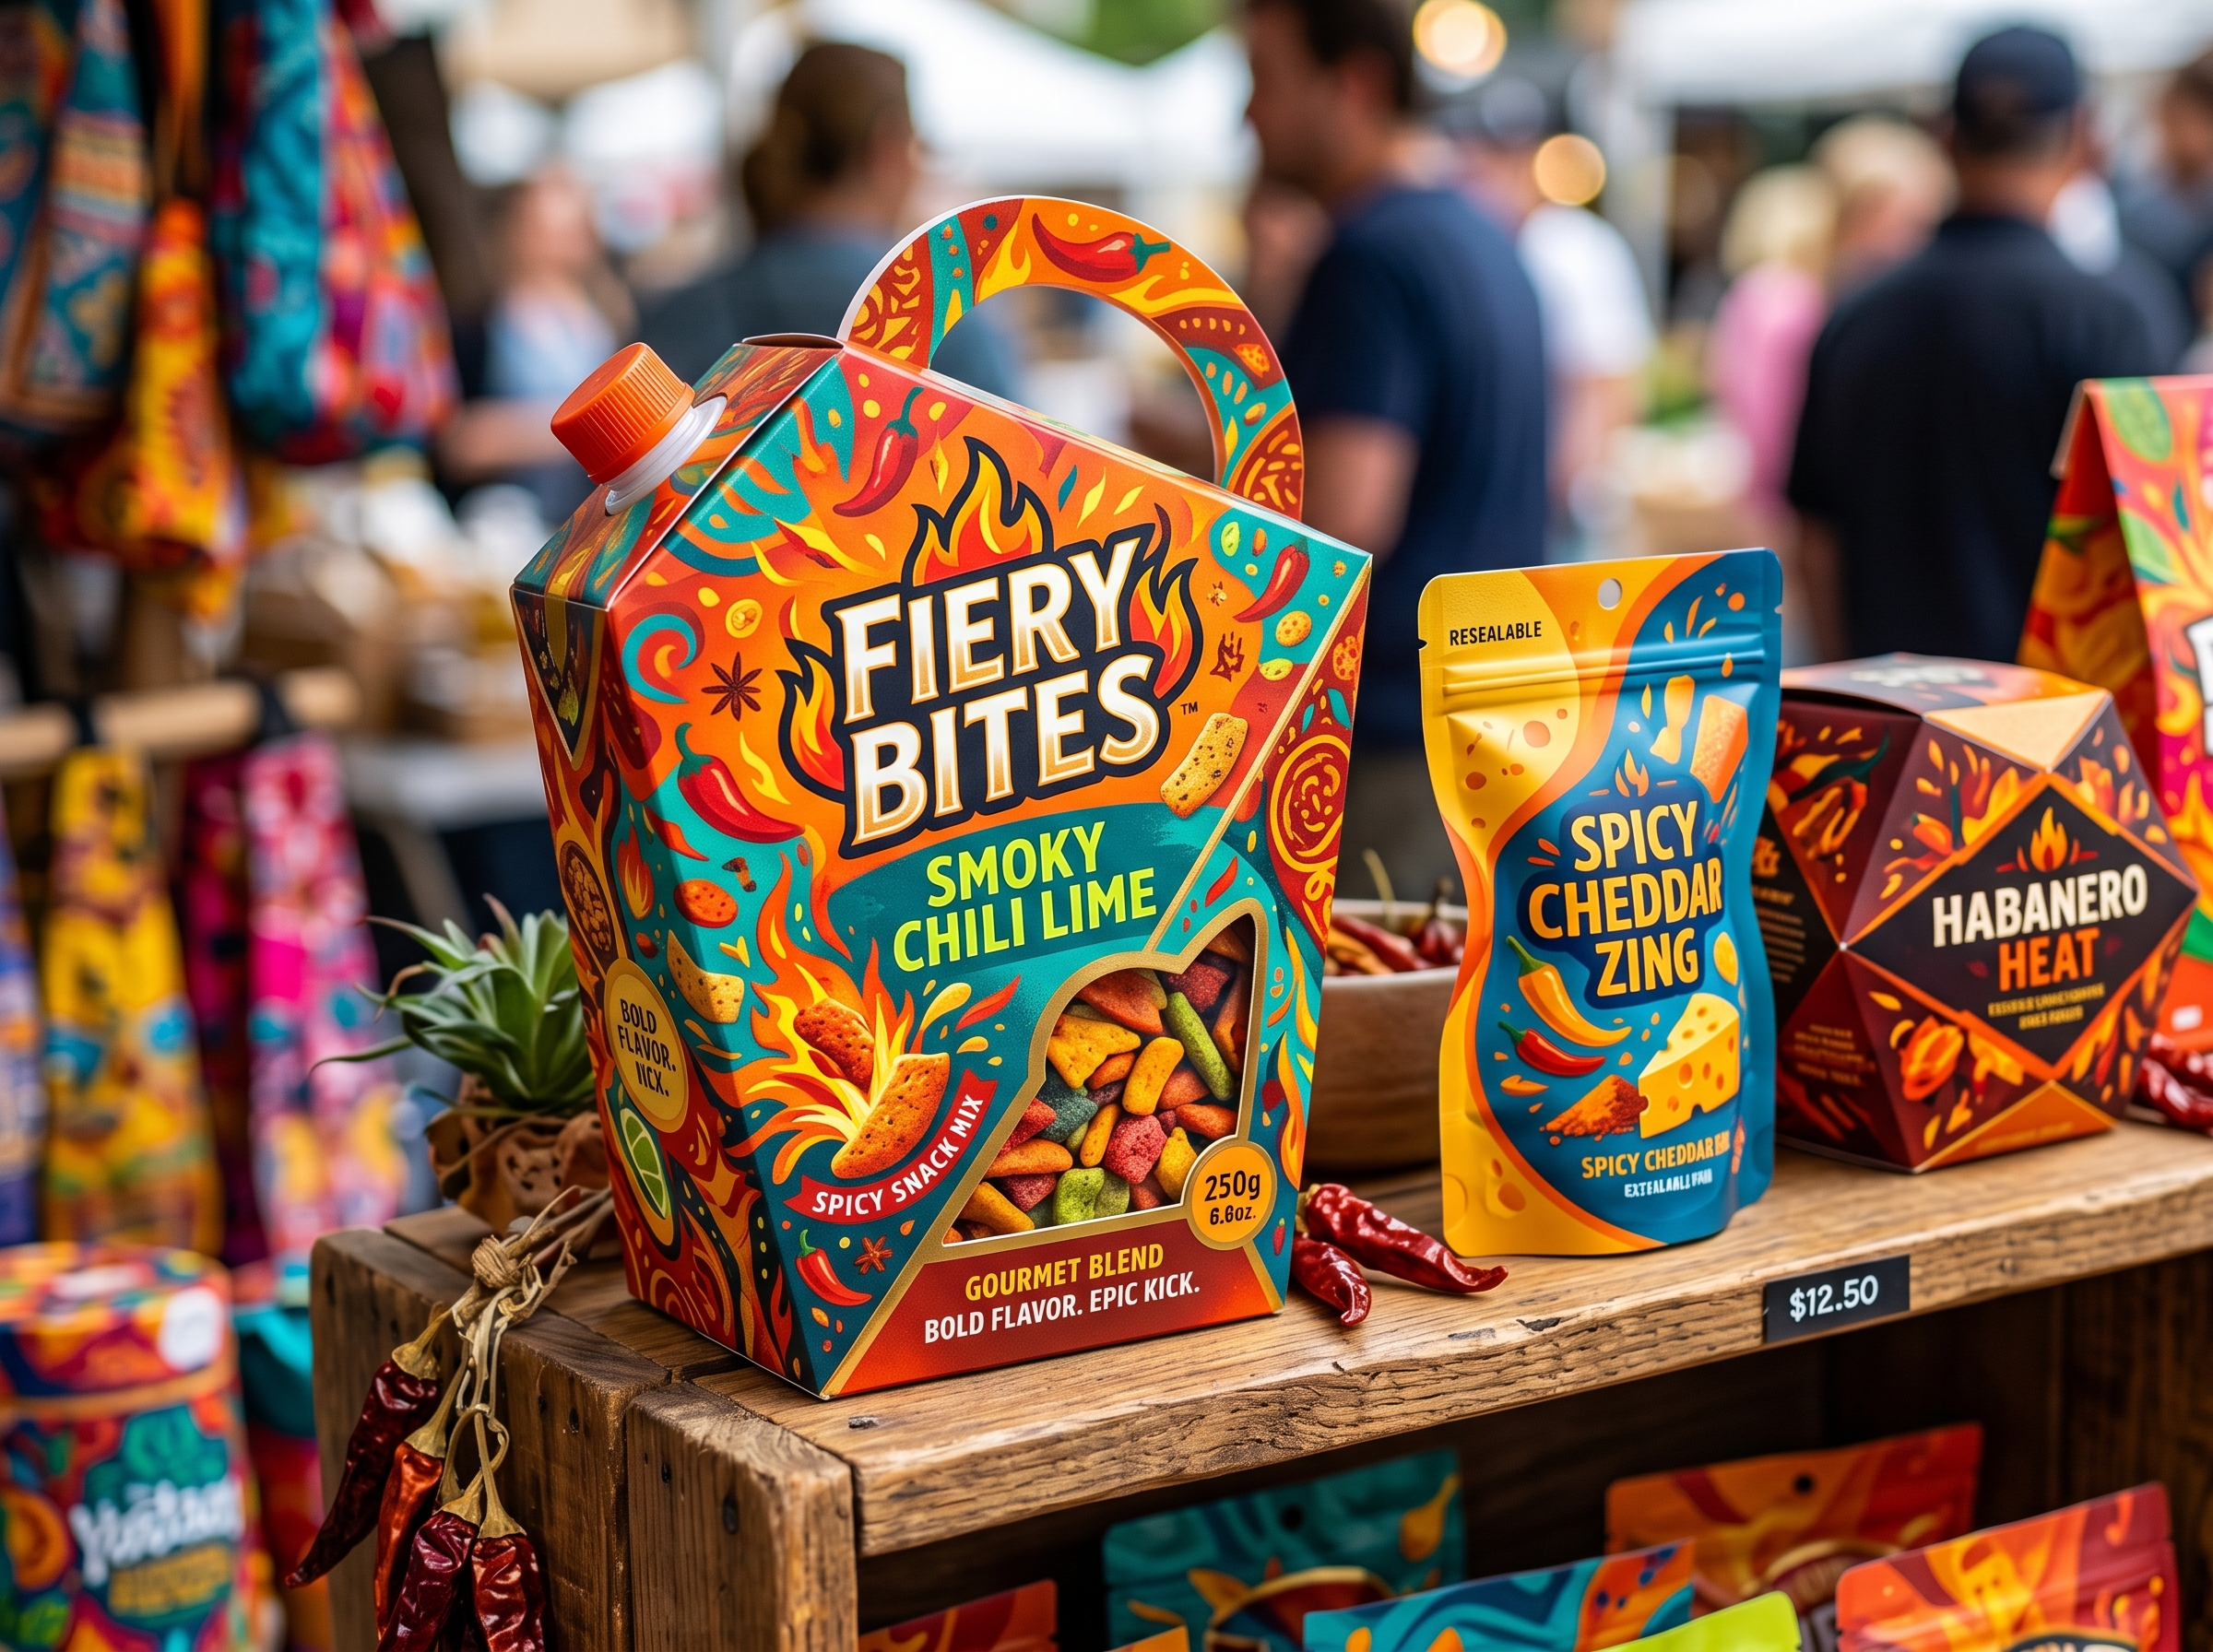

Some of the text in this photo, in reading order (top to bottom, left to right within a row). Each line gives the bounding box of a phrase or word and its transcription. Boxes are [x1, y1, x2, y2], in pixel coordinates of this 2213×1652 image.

[839, 537, 1140, 726] FIERY
[1450, 620, 1542, 646] RESEALABLE
[1180, 701, 1198, 715] TM
[850, 654, 1159, 845] BITES
[926, 820, 1106, 908] SMOKY
[1570, 800, 1698, 872] SPICY
[893, 867, 1157, 973] CHILI LIME
[1528, 856, 1722, 939] CHEDDAR
[1932, 863, 2148, 948] HABANERO
[1594, 927, 1699, 997] ZING
[1998, 926, 2101, 992] HEAT
[617, 1024, 677, 1072] FLAVOR.
[620, 997, 657, 1035] BOLD
[811, 1094, 984, 1216] SPICY SNACK MIX
[1204, 1170, 1261, 1202] 250g
[1580, 1152, 1640, 1179] SPICY
[1644, 1137, 1714, 1172] CHEDDAR
[1209, 1204, 1257, 1226] 6.6oz.
[964, 1243, 1165, 1302] GOURMET BLEND
[1789, 1274, 1879, 1323] $12.50
[925, 1270, 1201, 1344] BOLD FLAVOR. EPIC KICK.
